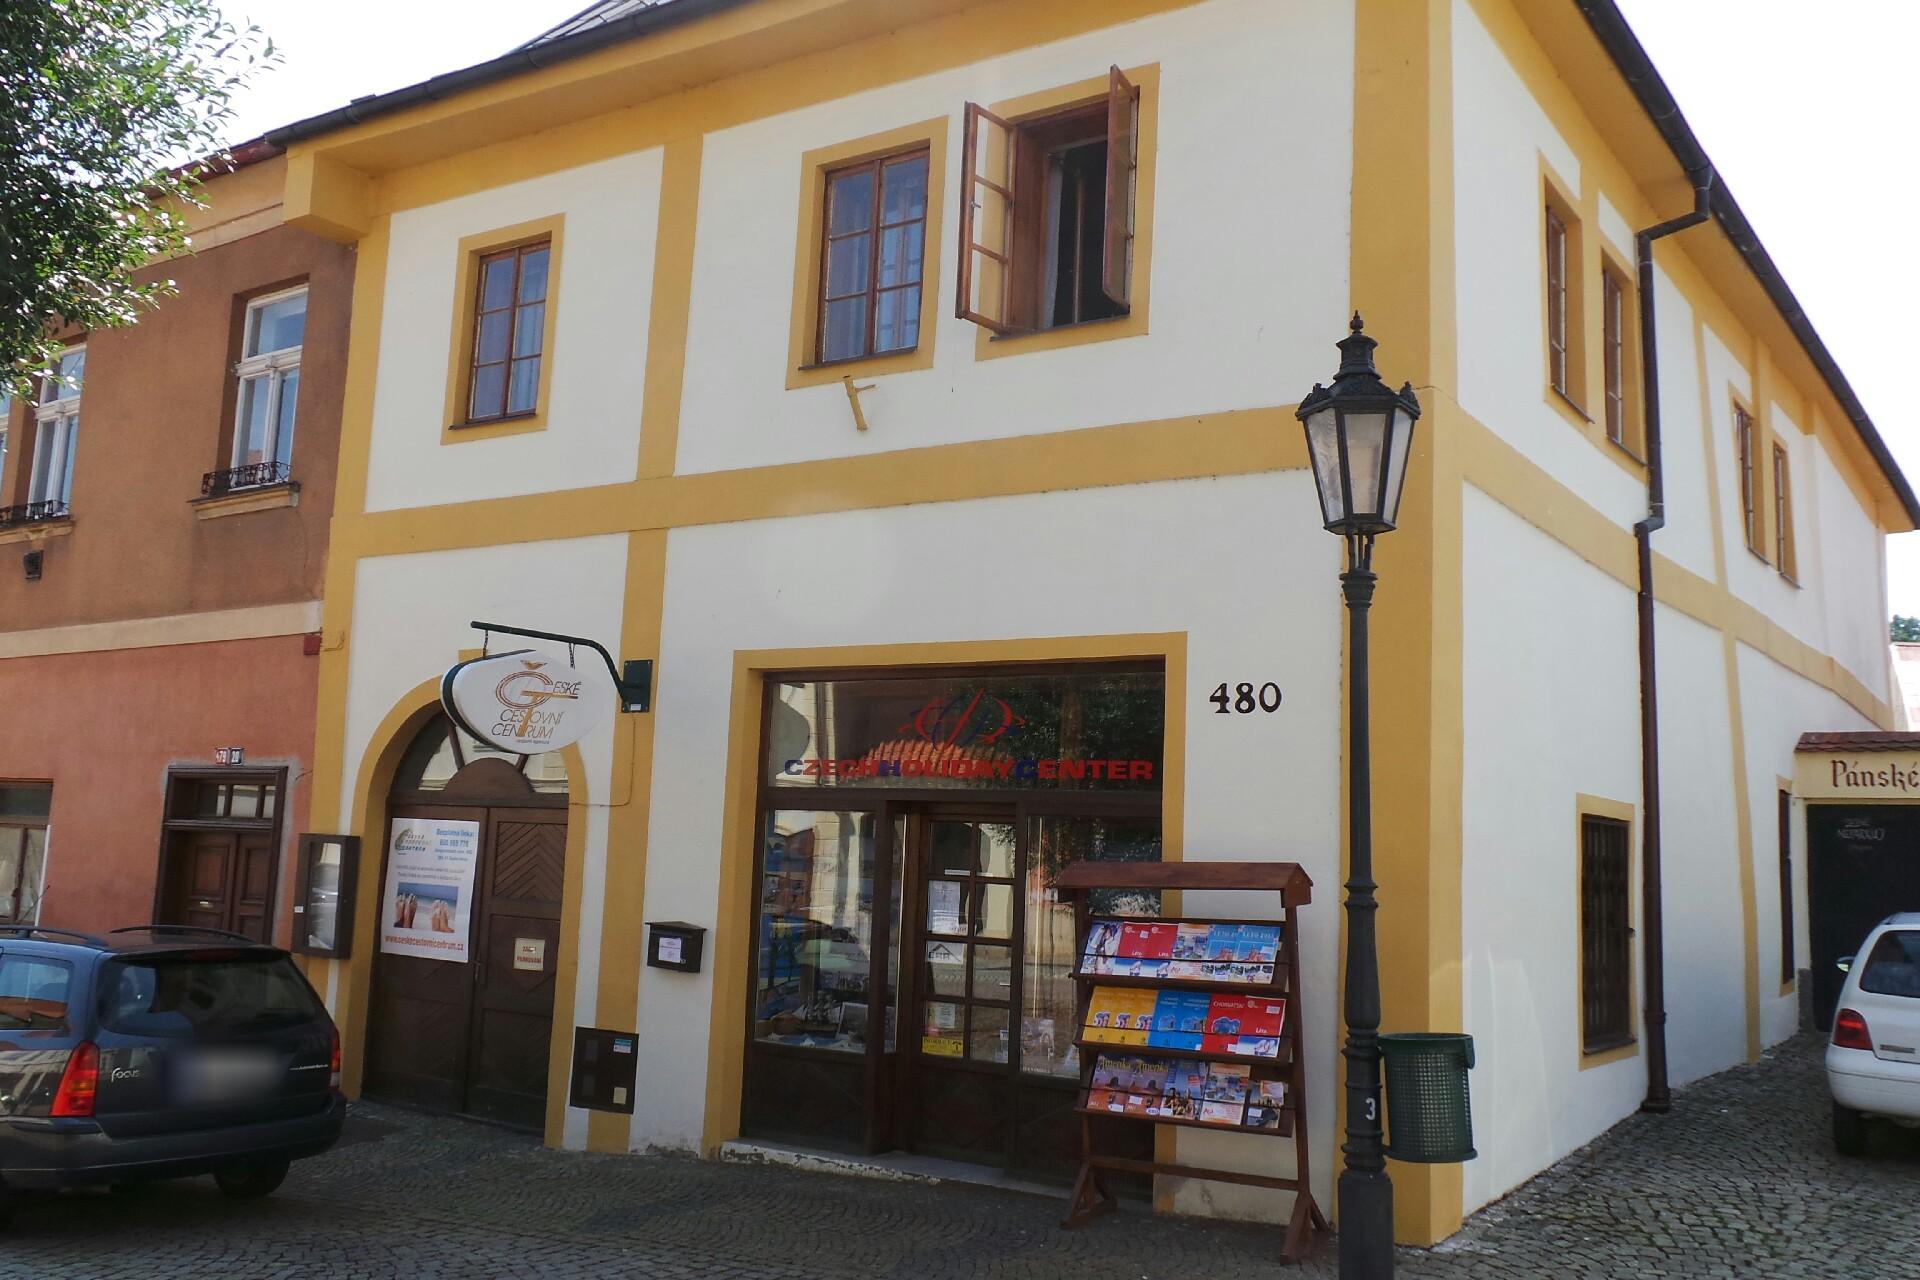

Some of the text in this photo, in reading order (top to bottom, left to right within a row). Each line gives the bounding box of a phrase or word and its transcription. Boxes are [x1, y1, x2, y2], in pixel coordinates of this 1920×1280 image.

[1209, 682, 1282, 714] 480
[491, 722, 554, 739] CENTRUM
[1831, 760, 1920, 792] Pánské
[1365, 1097, 1376, 1120] 3
